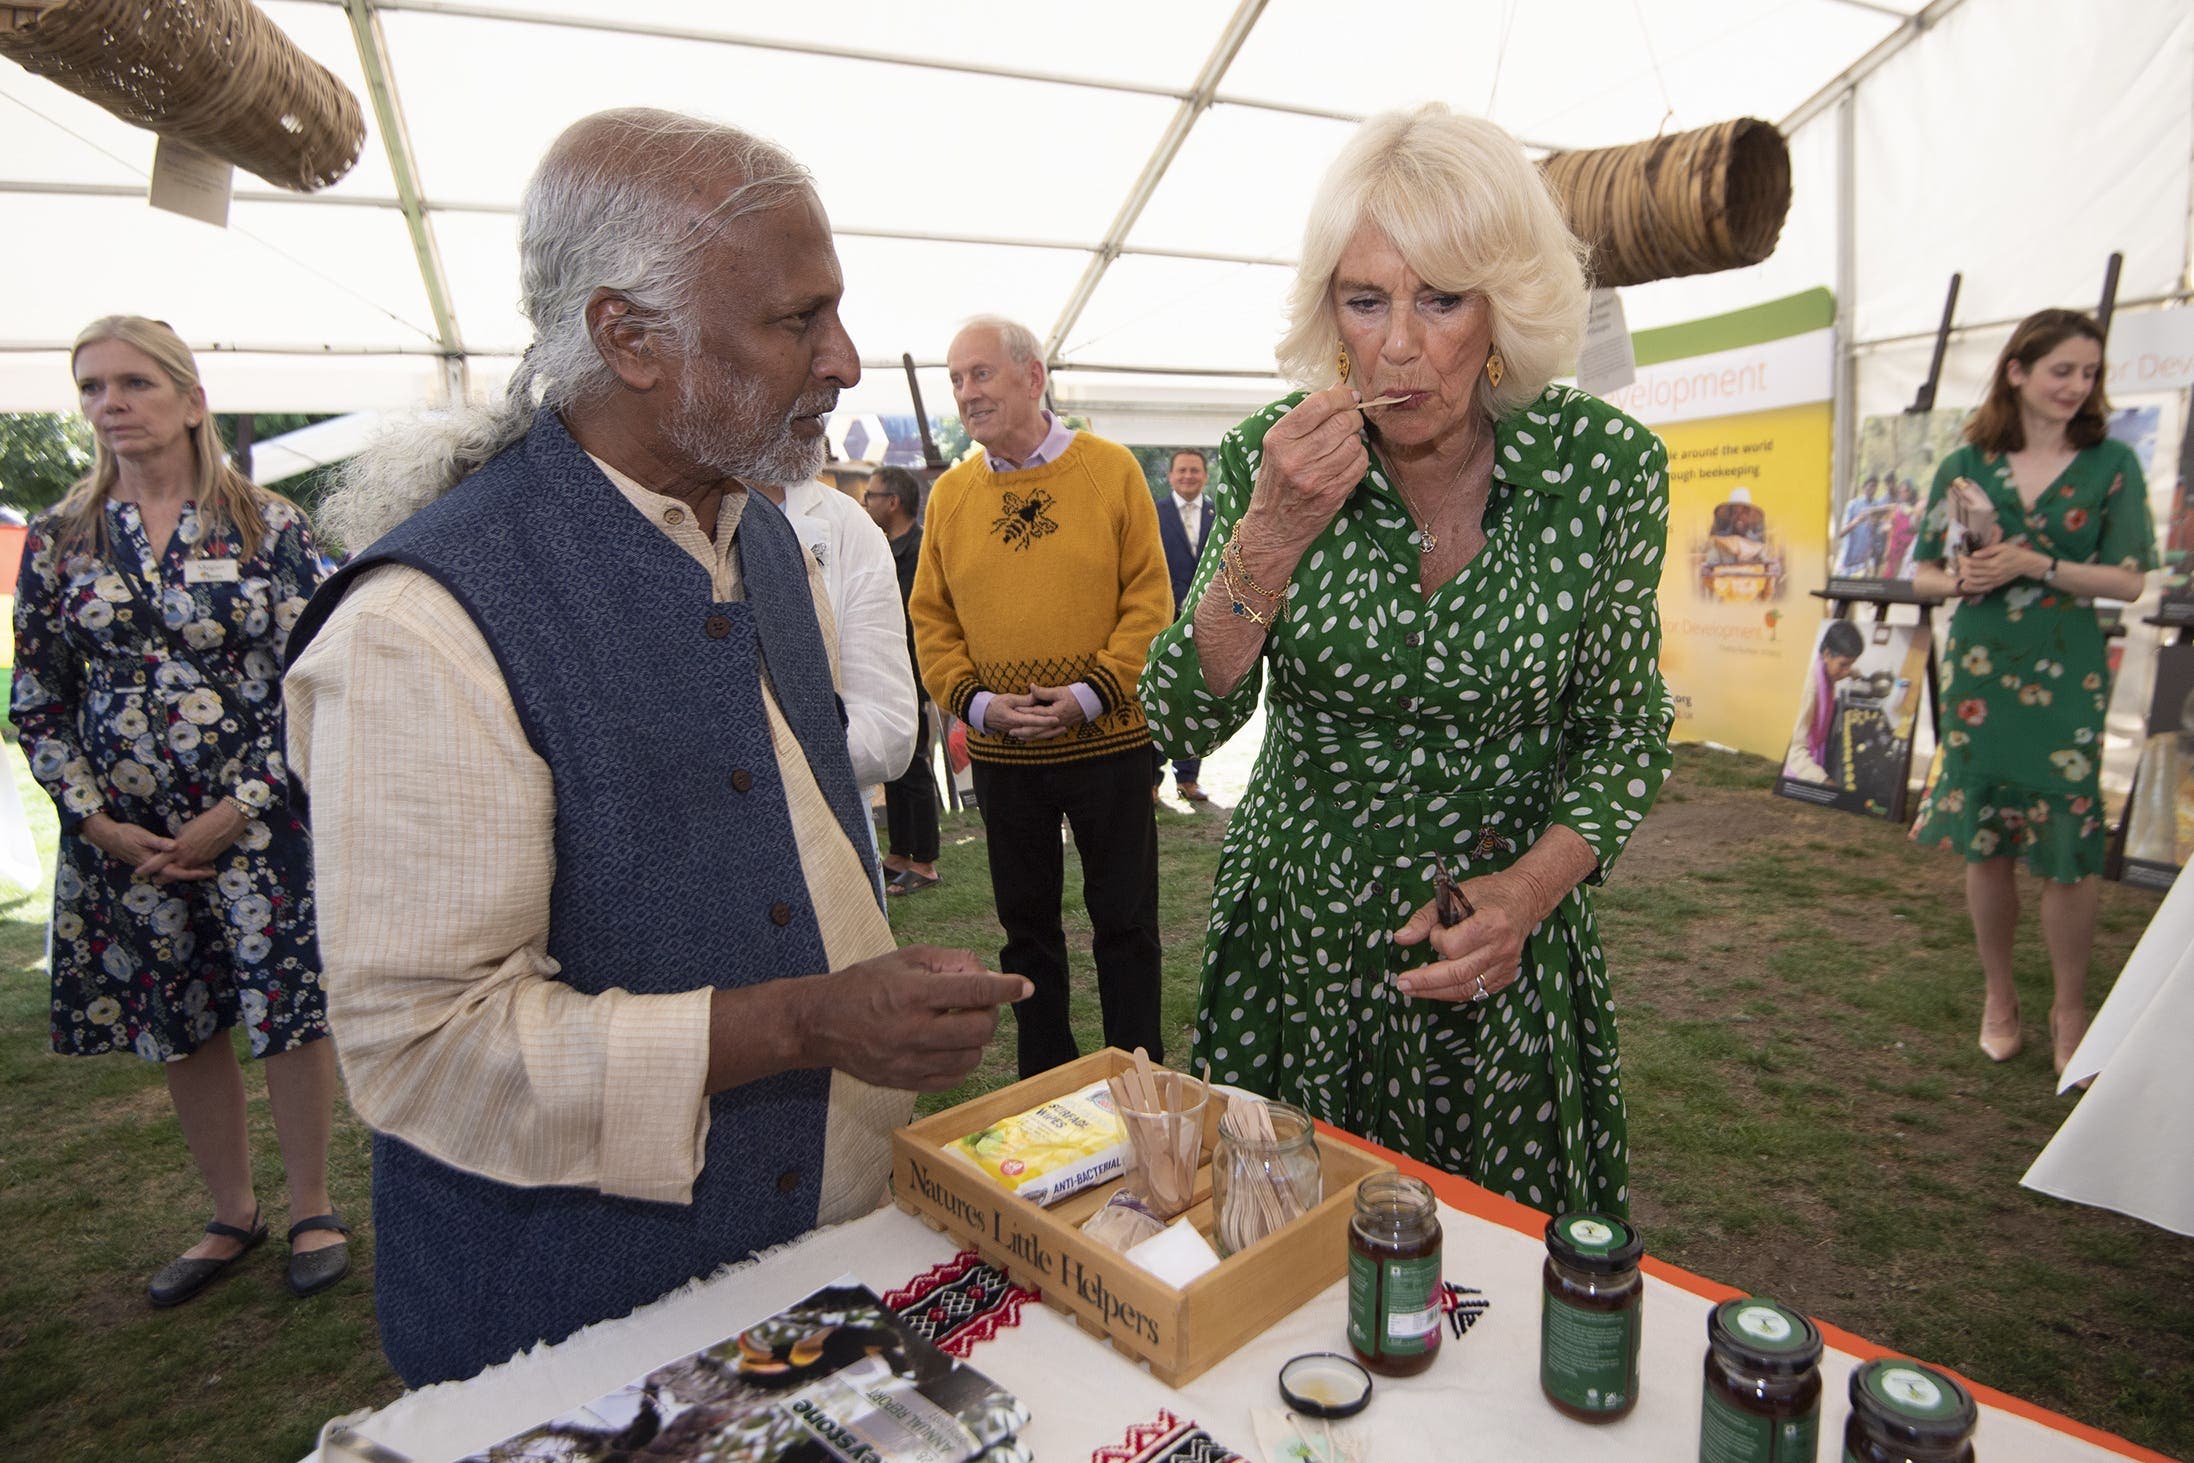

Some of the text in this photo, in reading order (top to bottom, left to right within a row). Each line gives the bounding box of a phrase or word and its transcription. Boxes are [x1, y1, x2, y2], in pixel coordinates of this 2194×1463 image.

[1681, 447, 1719, 460] around
[1722, 445, 1739, 456] the
[1743, 439, 1774, 453] world
[1700, 464, 1760, 479] beekeeping
[1053, 1157, 1122, 1194] ANTI-BACTERIAL
[909, 1158, 1159, 1345] Natures Little Helpers
[865, 1387, 912, 1420] REPORT
[793, 1399, 885, 1463] eystone
[906, 1414, 956, 1453] ANNUAL
